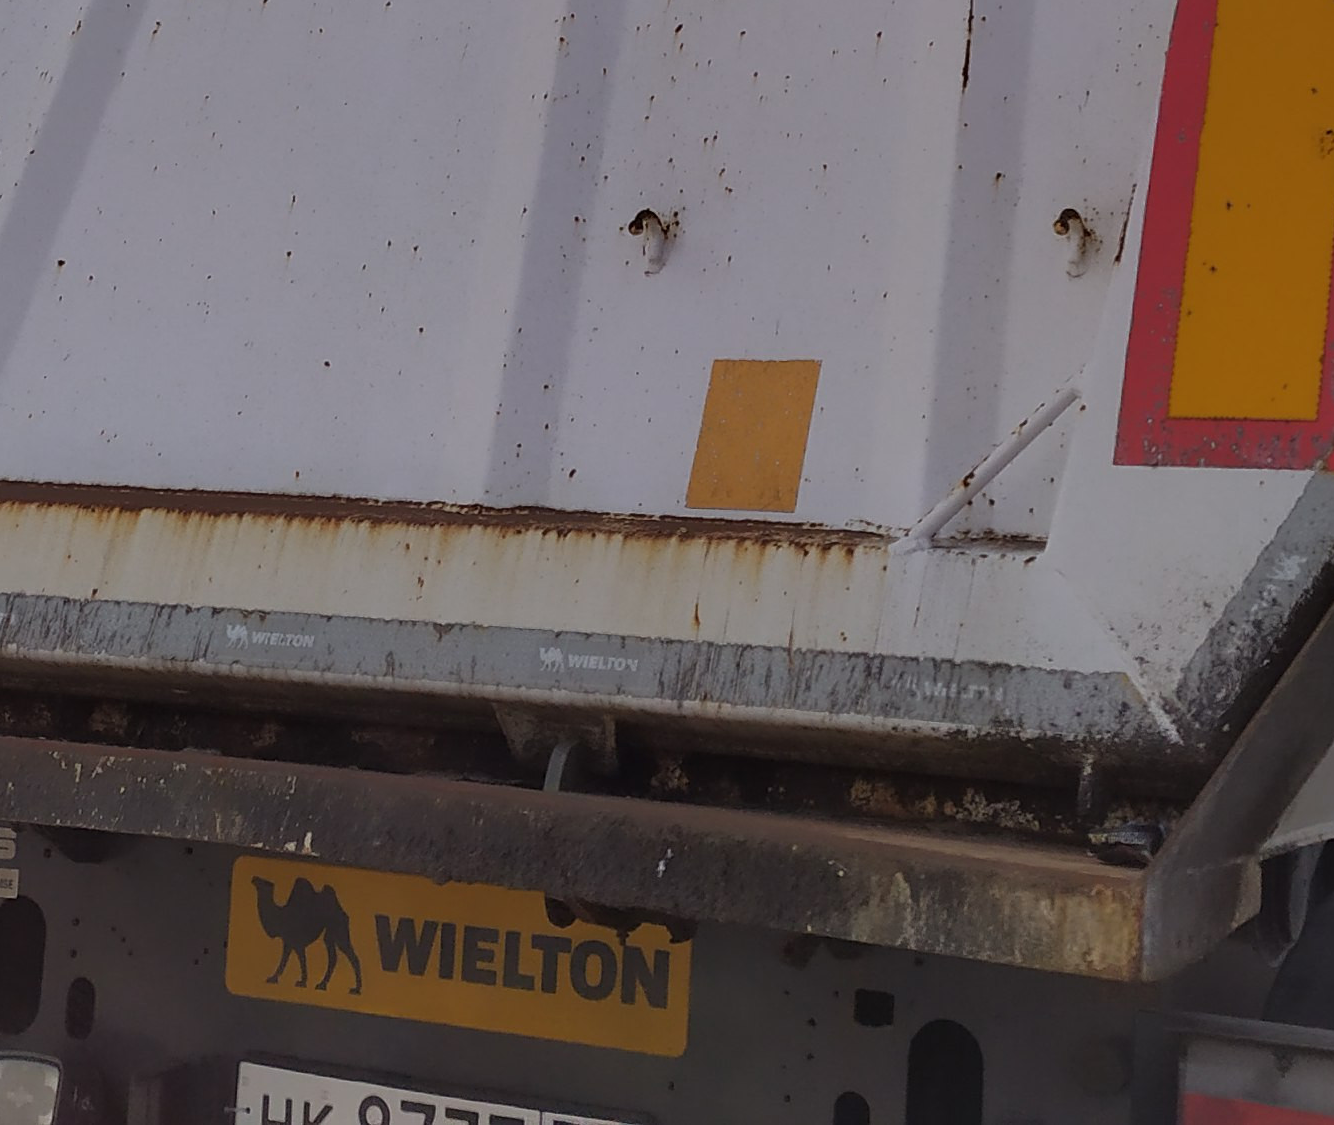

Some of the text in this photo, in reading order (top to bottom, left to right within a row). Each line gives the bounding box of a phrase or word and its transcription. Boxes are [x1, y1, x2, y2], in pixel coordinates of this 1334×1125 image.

[251, 631, 315, 648] WIELTON
[568, 654, 639, 672] WIELTON
[374, 914, 670, 1009] WIELTON
